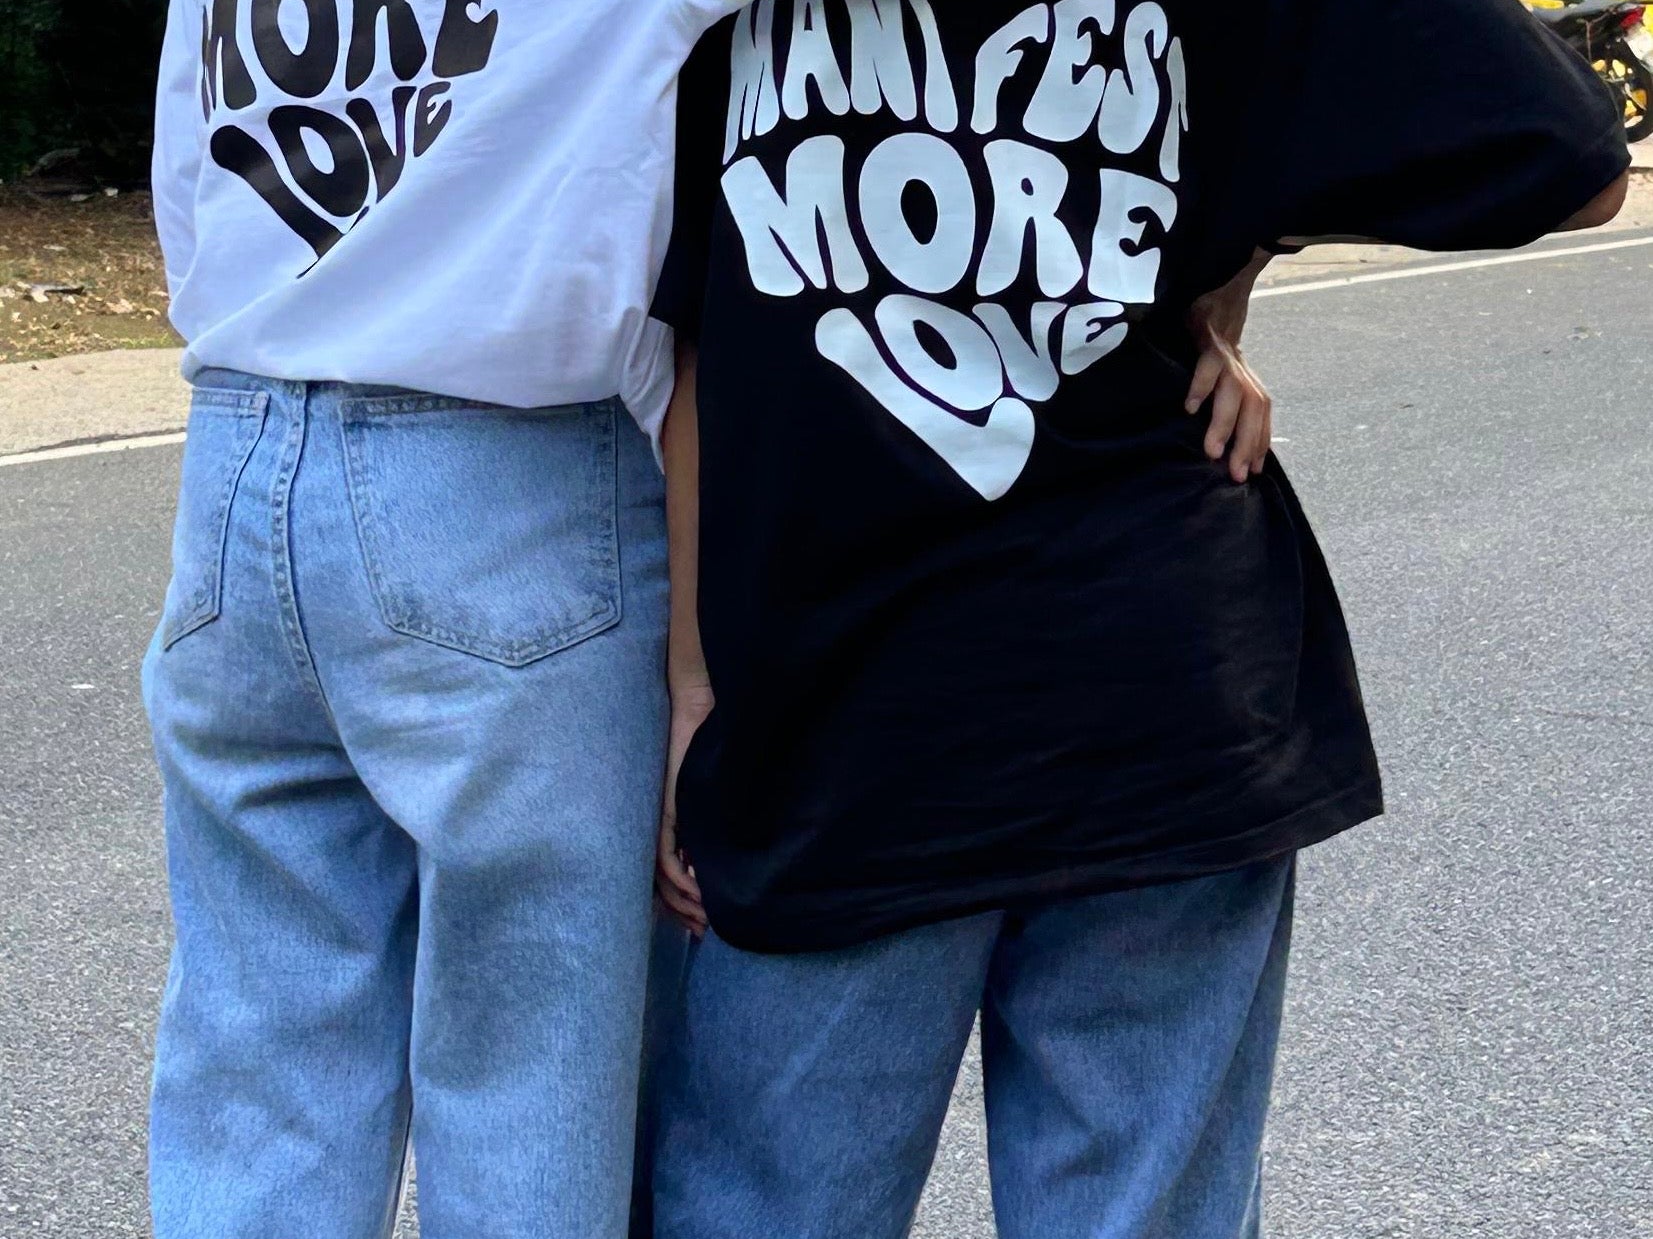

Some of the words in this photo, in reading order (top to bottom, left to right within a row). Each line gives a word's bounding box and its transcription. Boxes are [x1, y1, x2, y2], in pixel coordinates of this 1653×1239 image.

[210, 81, 452, 279] LOVE
[720, 132, 1177, 303] MORE
[815, 293, 1128, 501] LOVE
